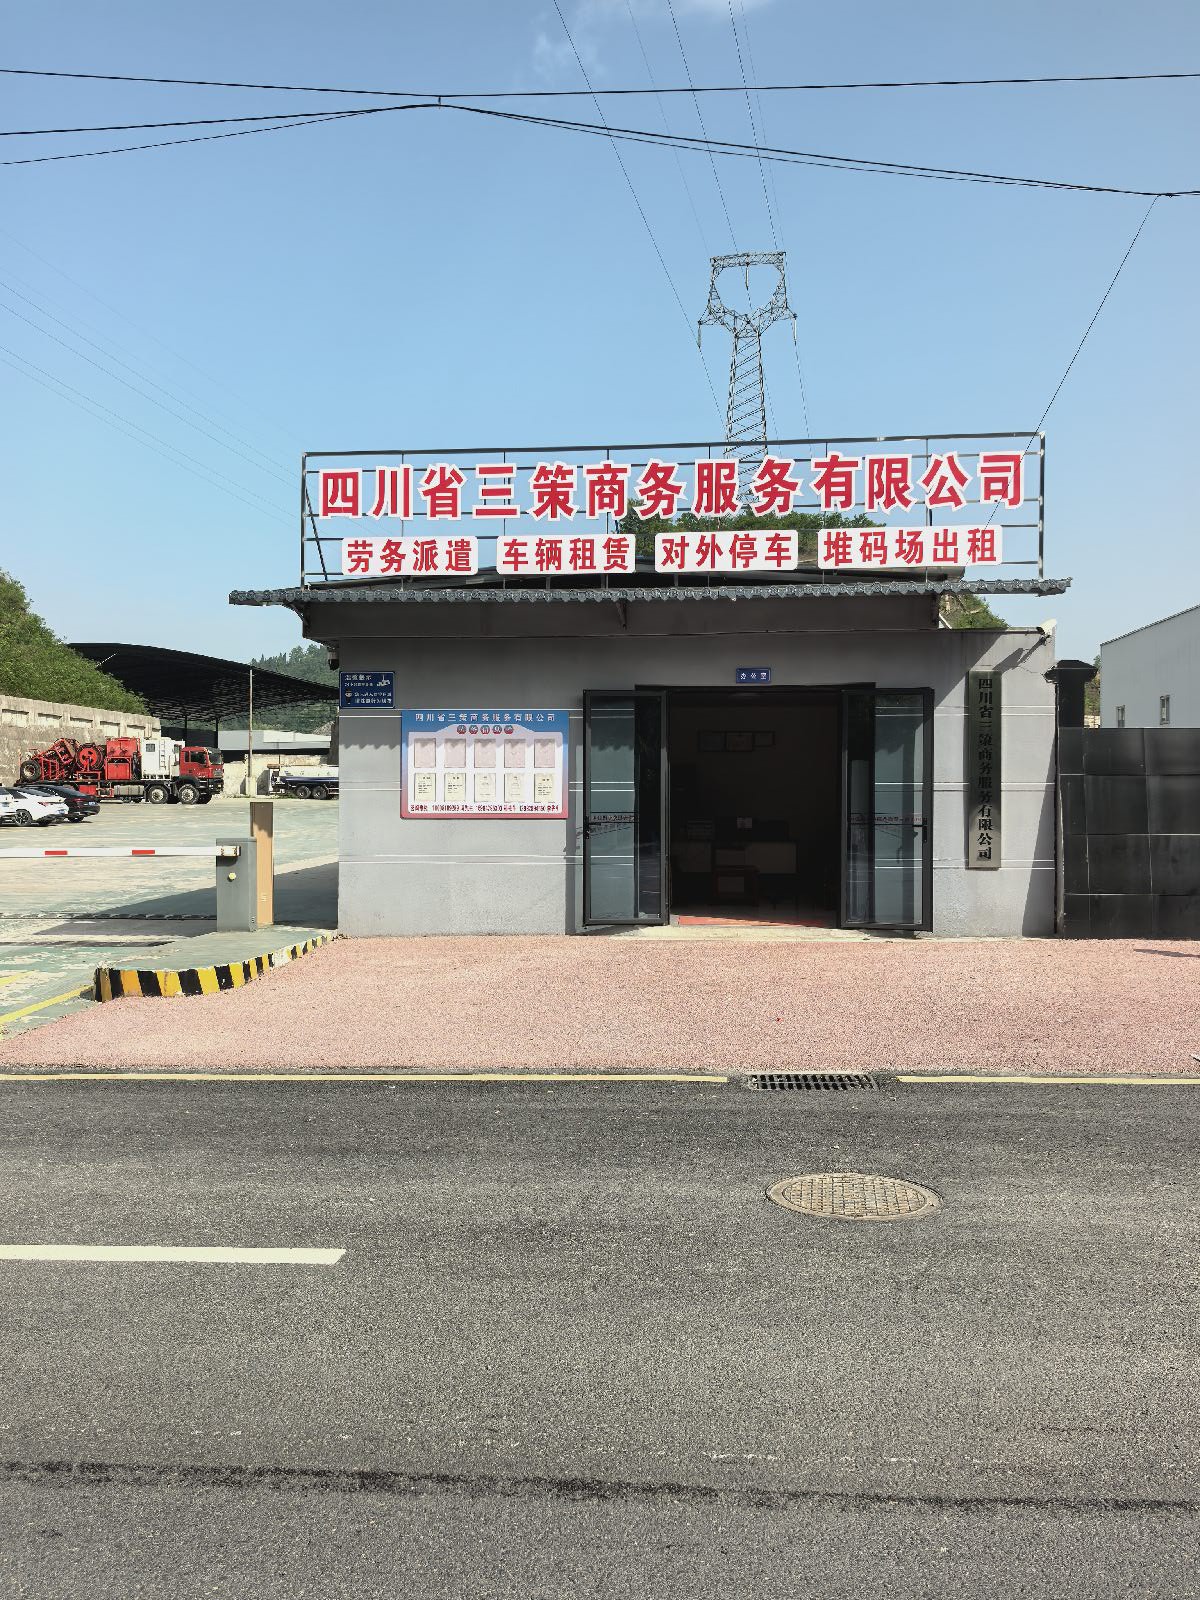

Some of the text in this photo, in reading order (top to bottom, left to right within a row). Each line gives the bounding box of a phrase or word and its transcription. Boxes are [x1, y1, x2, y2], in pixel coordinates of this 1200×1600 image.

[320, 454, 1024, 519] 四川省三策商务服务有限公司
[347, 538, 473, 572] 劳务派遣
[502, 537, 631, 571] 车辆租赁
[661, 533, 792, 569] 对外停车
[823, 528, 998, 566] 堆码场出租
